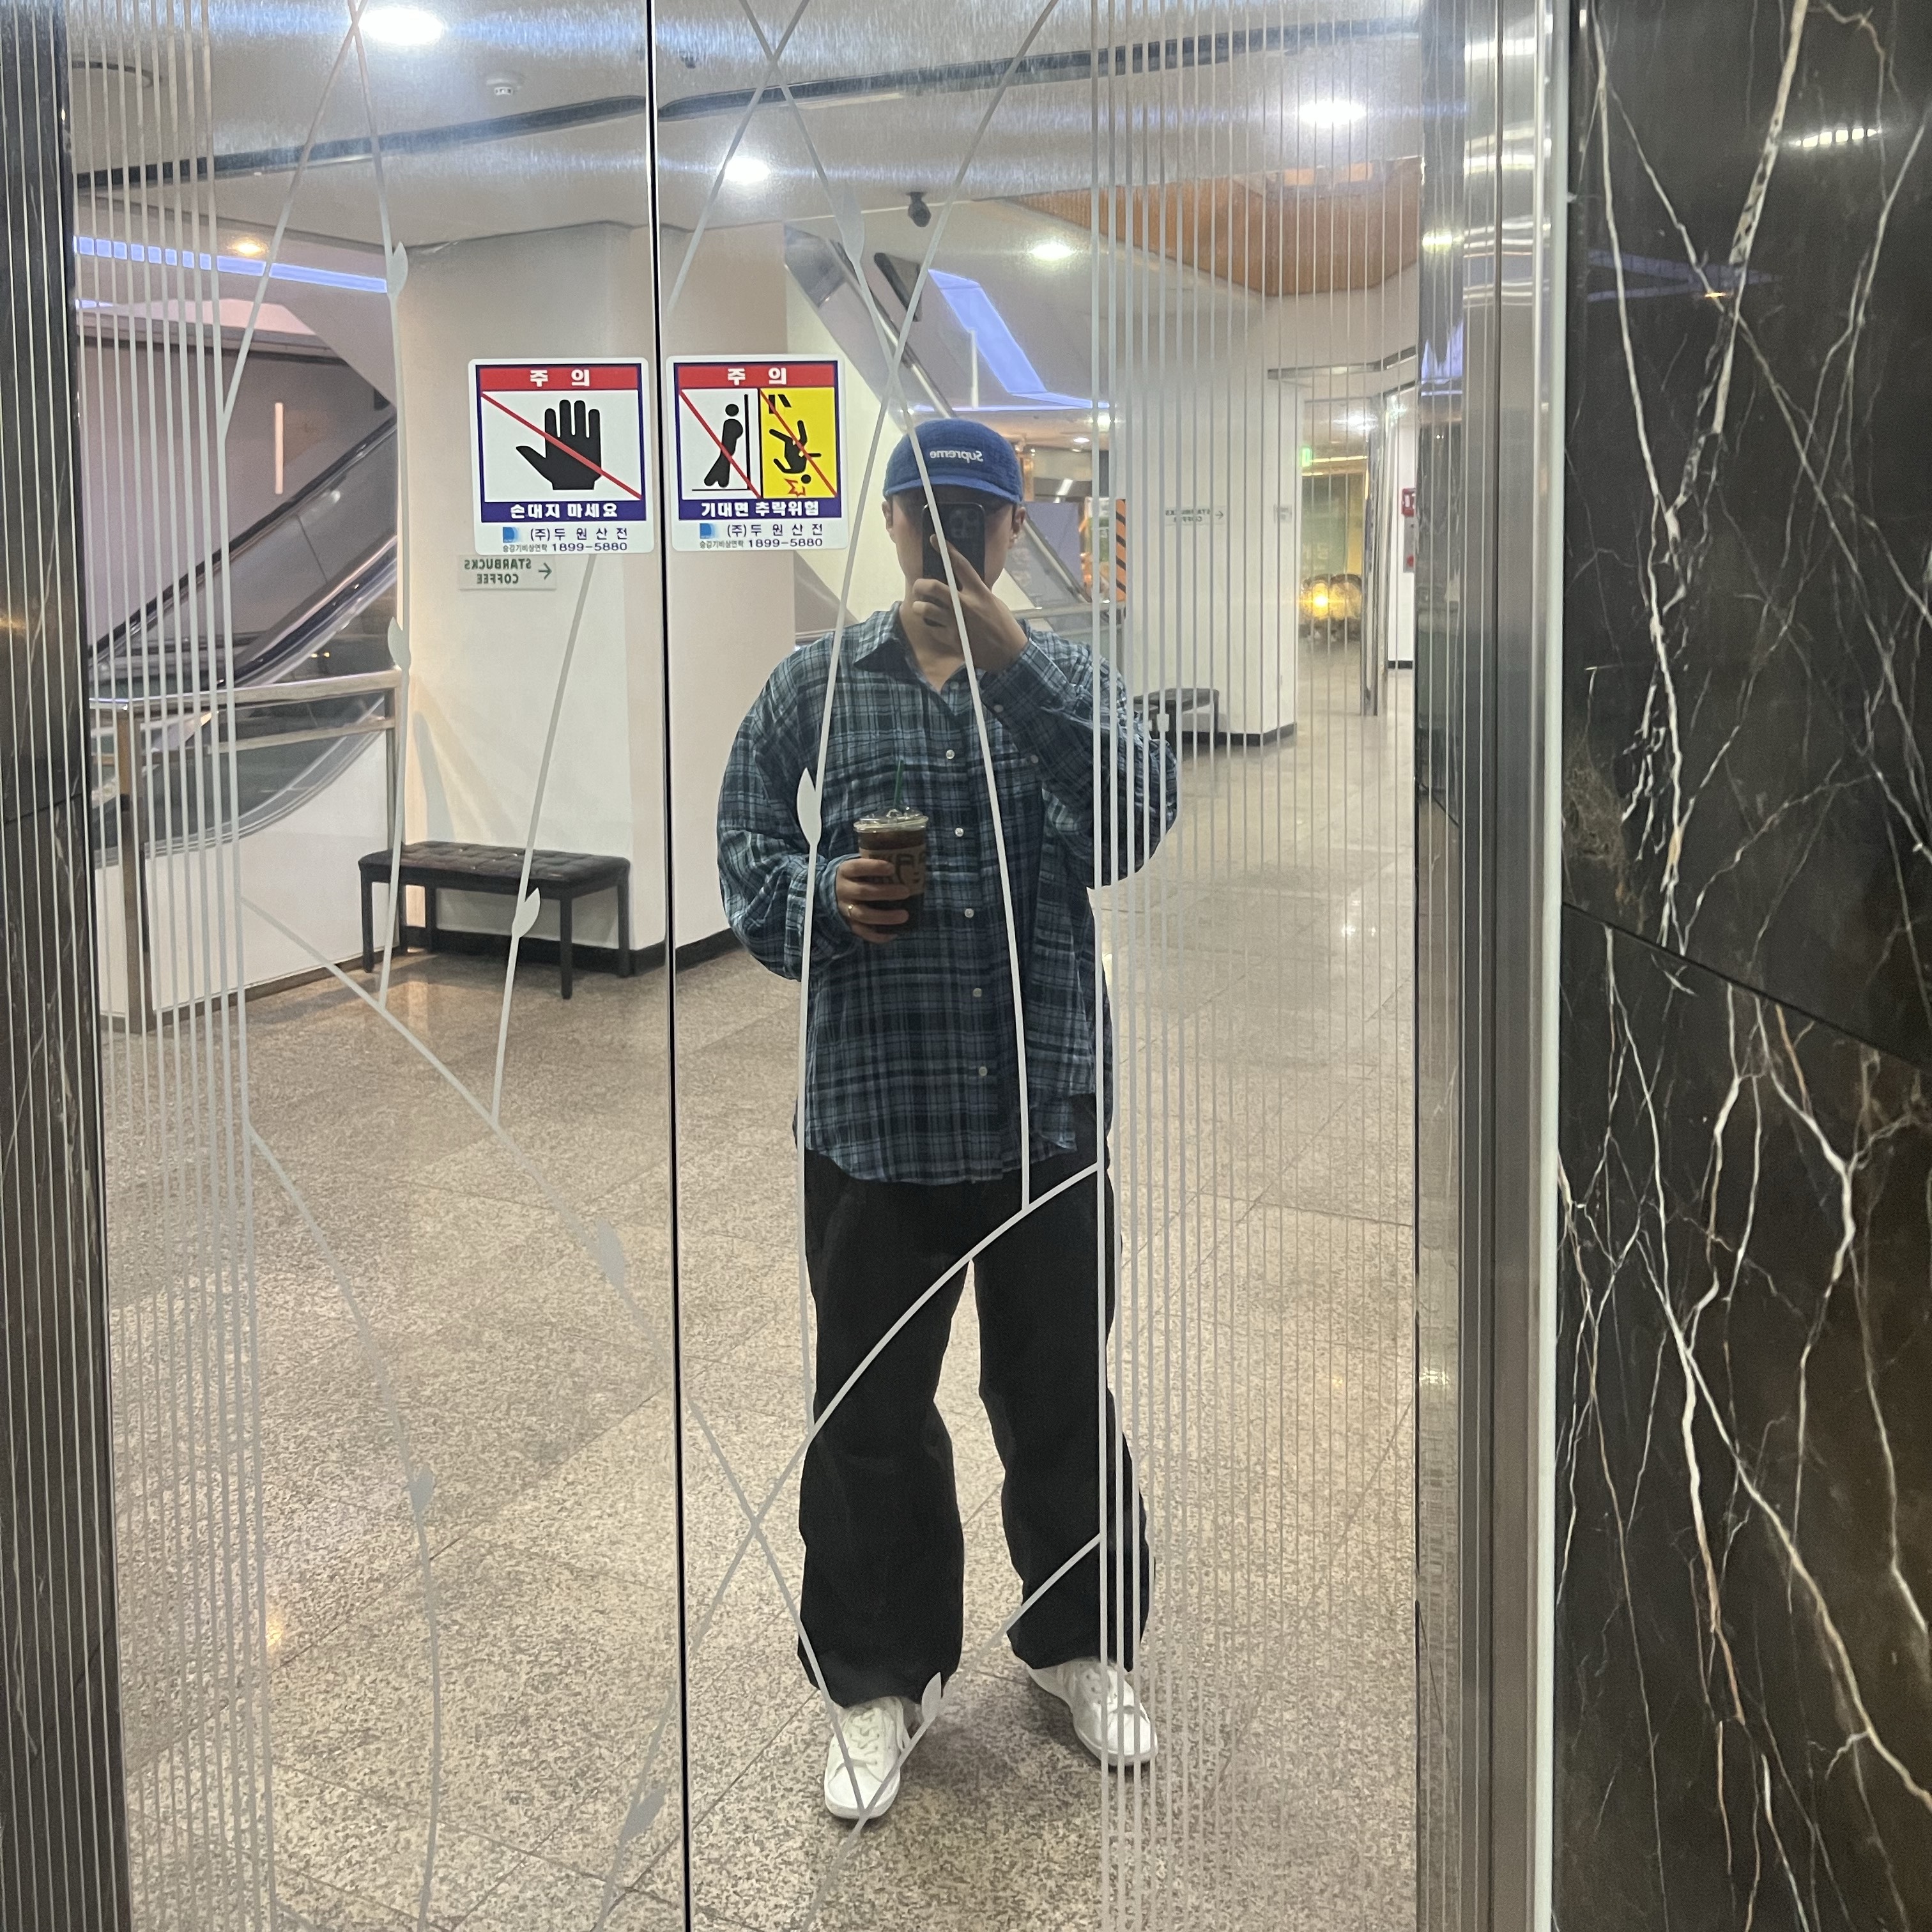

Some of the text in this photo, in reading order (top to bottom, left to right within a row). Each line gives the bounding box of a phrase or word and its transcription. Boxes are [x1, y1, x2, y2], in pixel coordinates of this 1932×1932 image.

[510, 502, 618, 519] 손대지 마세요
[701, 501, 819, 518] 기대면 추락위험
[552, 542, 627, 552] 1899-5880
[749, 538, 823, 548] 1899-5880
